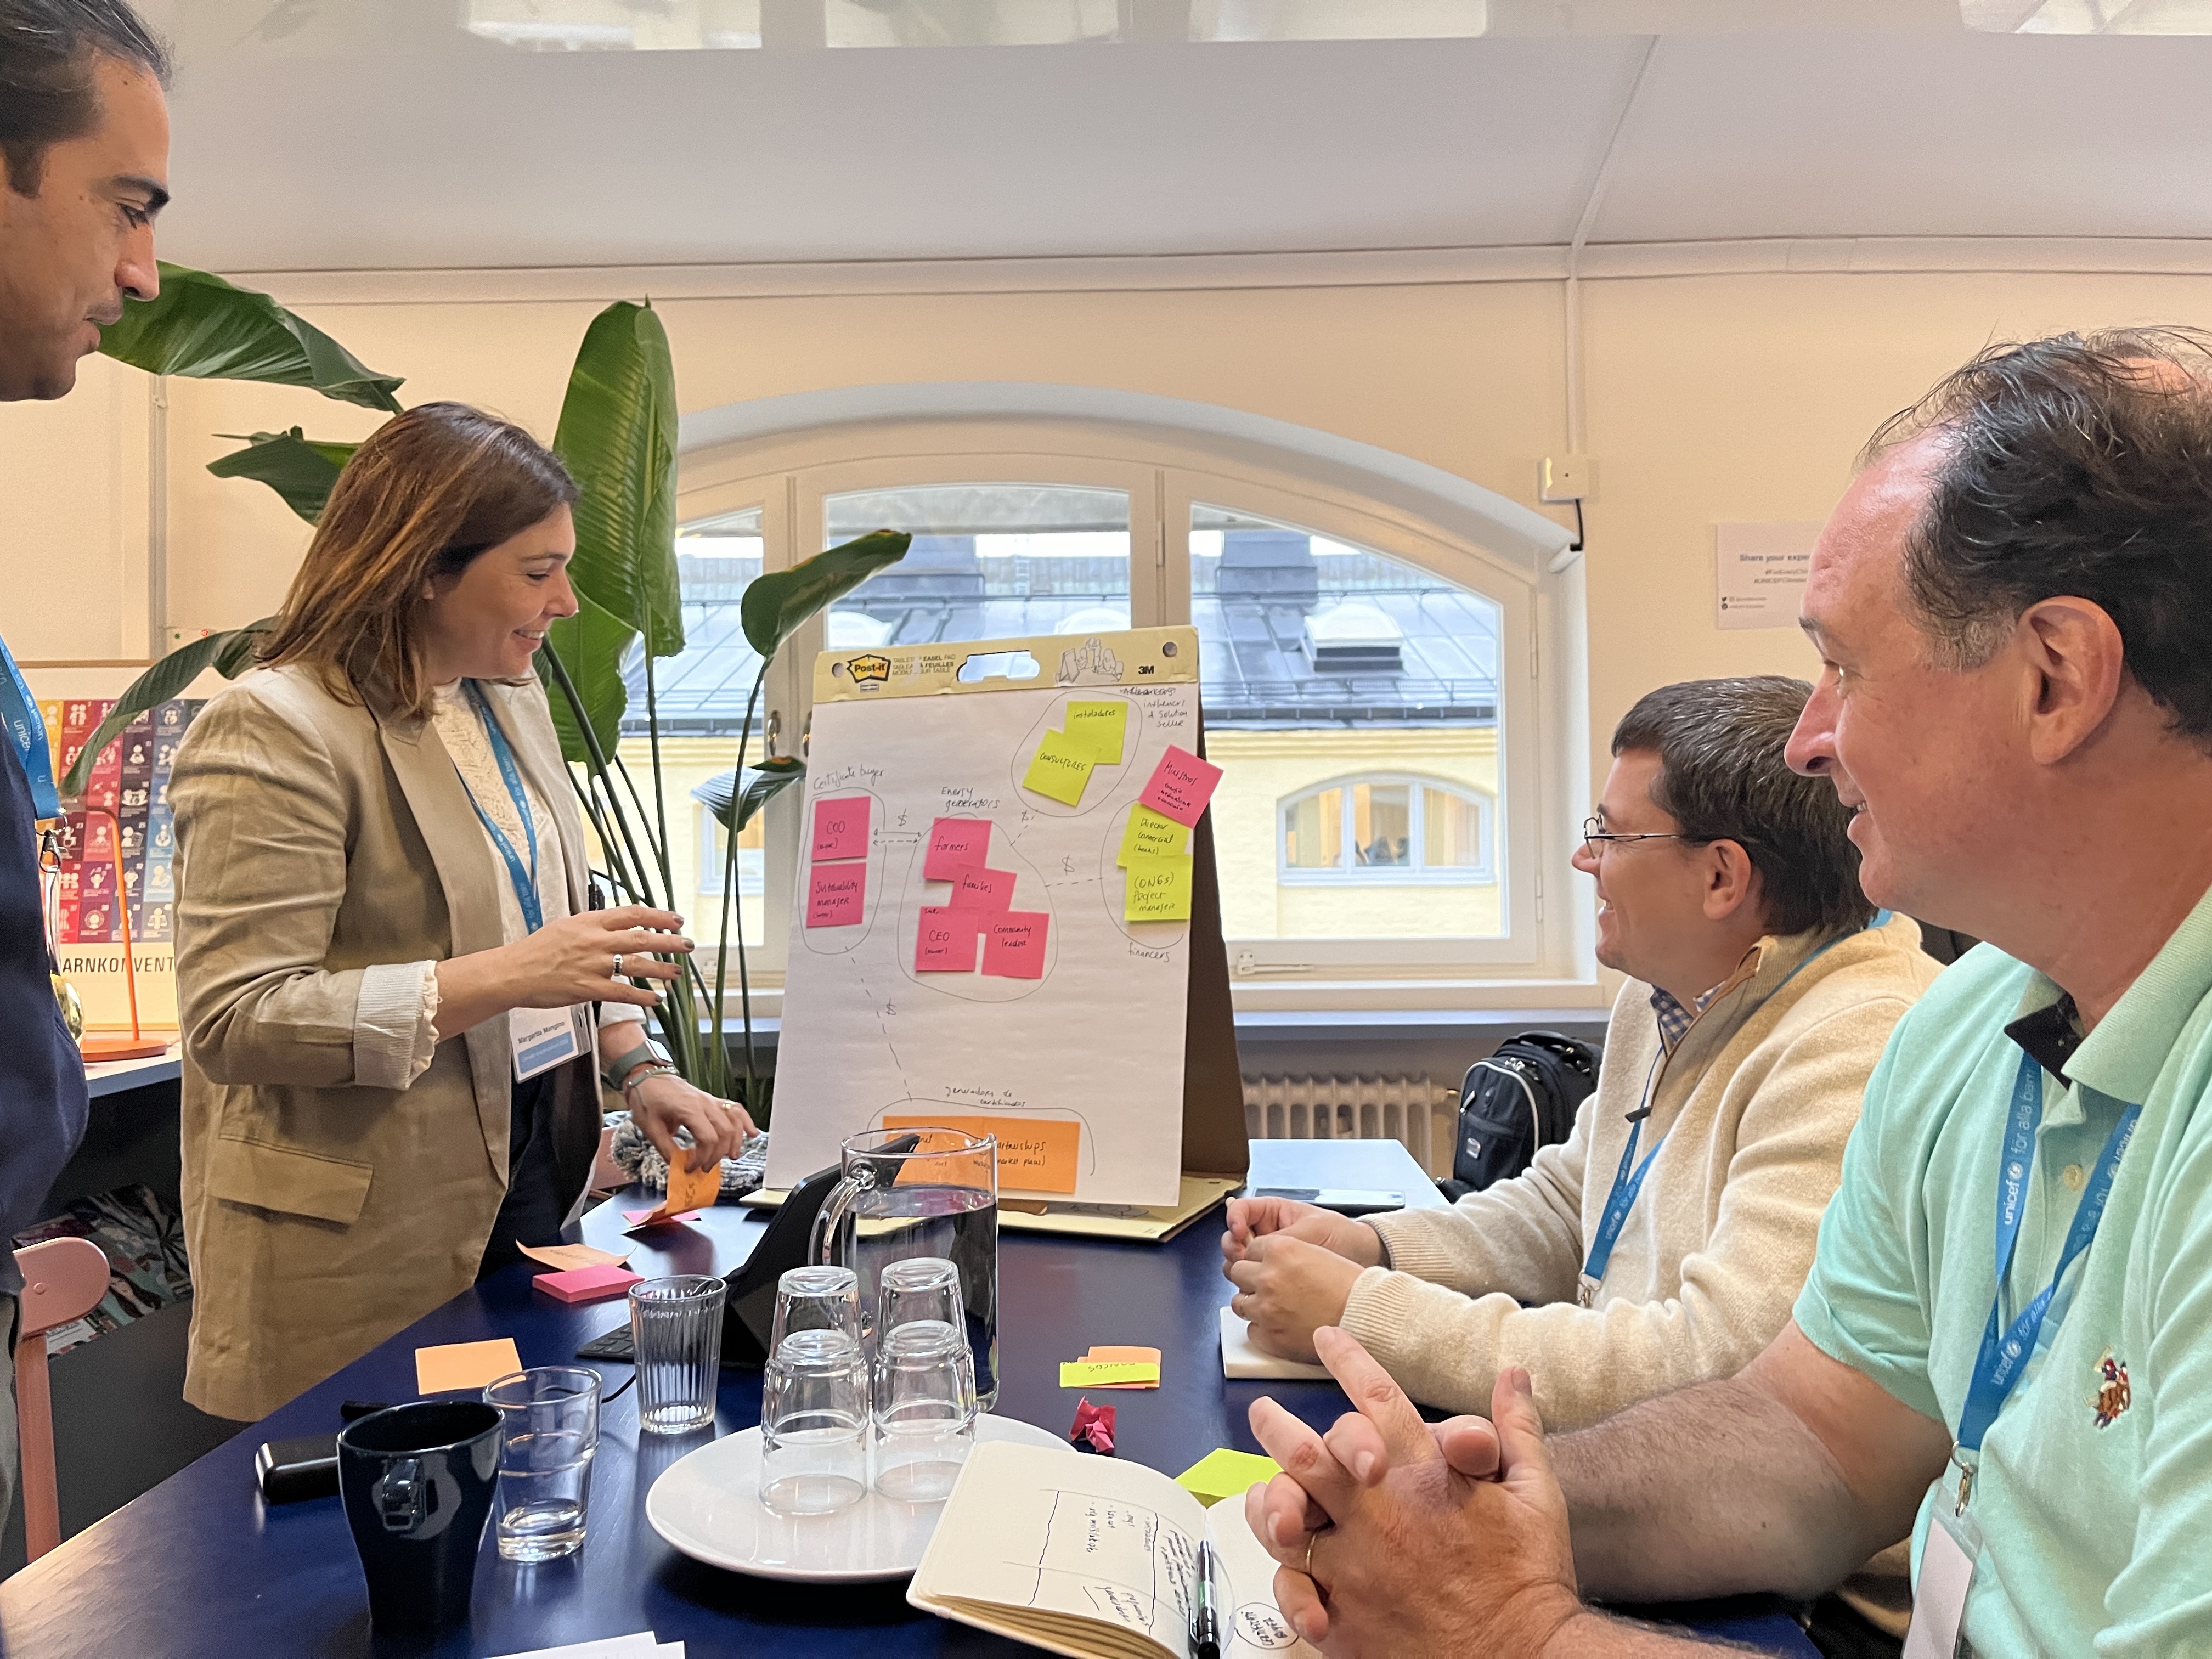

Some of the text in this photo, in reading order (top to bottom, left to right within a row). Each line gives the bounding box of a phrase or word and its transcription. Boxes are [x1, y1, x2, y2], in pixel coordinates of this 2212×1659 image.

[854, 663, 885, 673] Post-it
[1138, 665, 1154, 674] 3M
[929, 929, 950, 942] CEO
[2004, 1178, 2020, 1226] unicef
